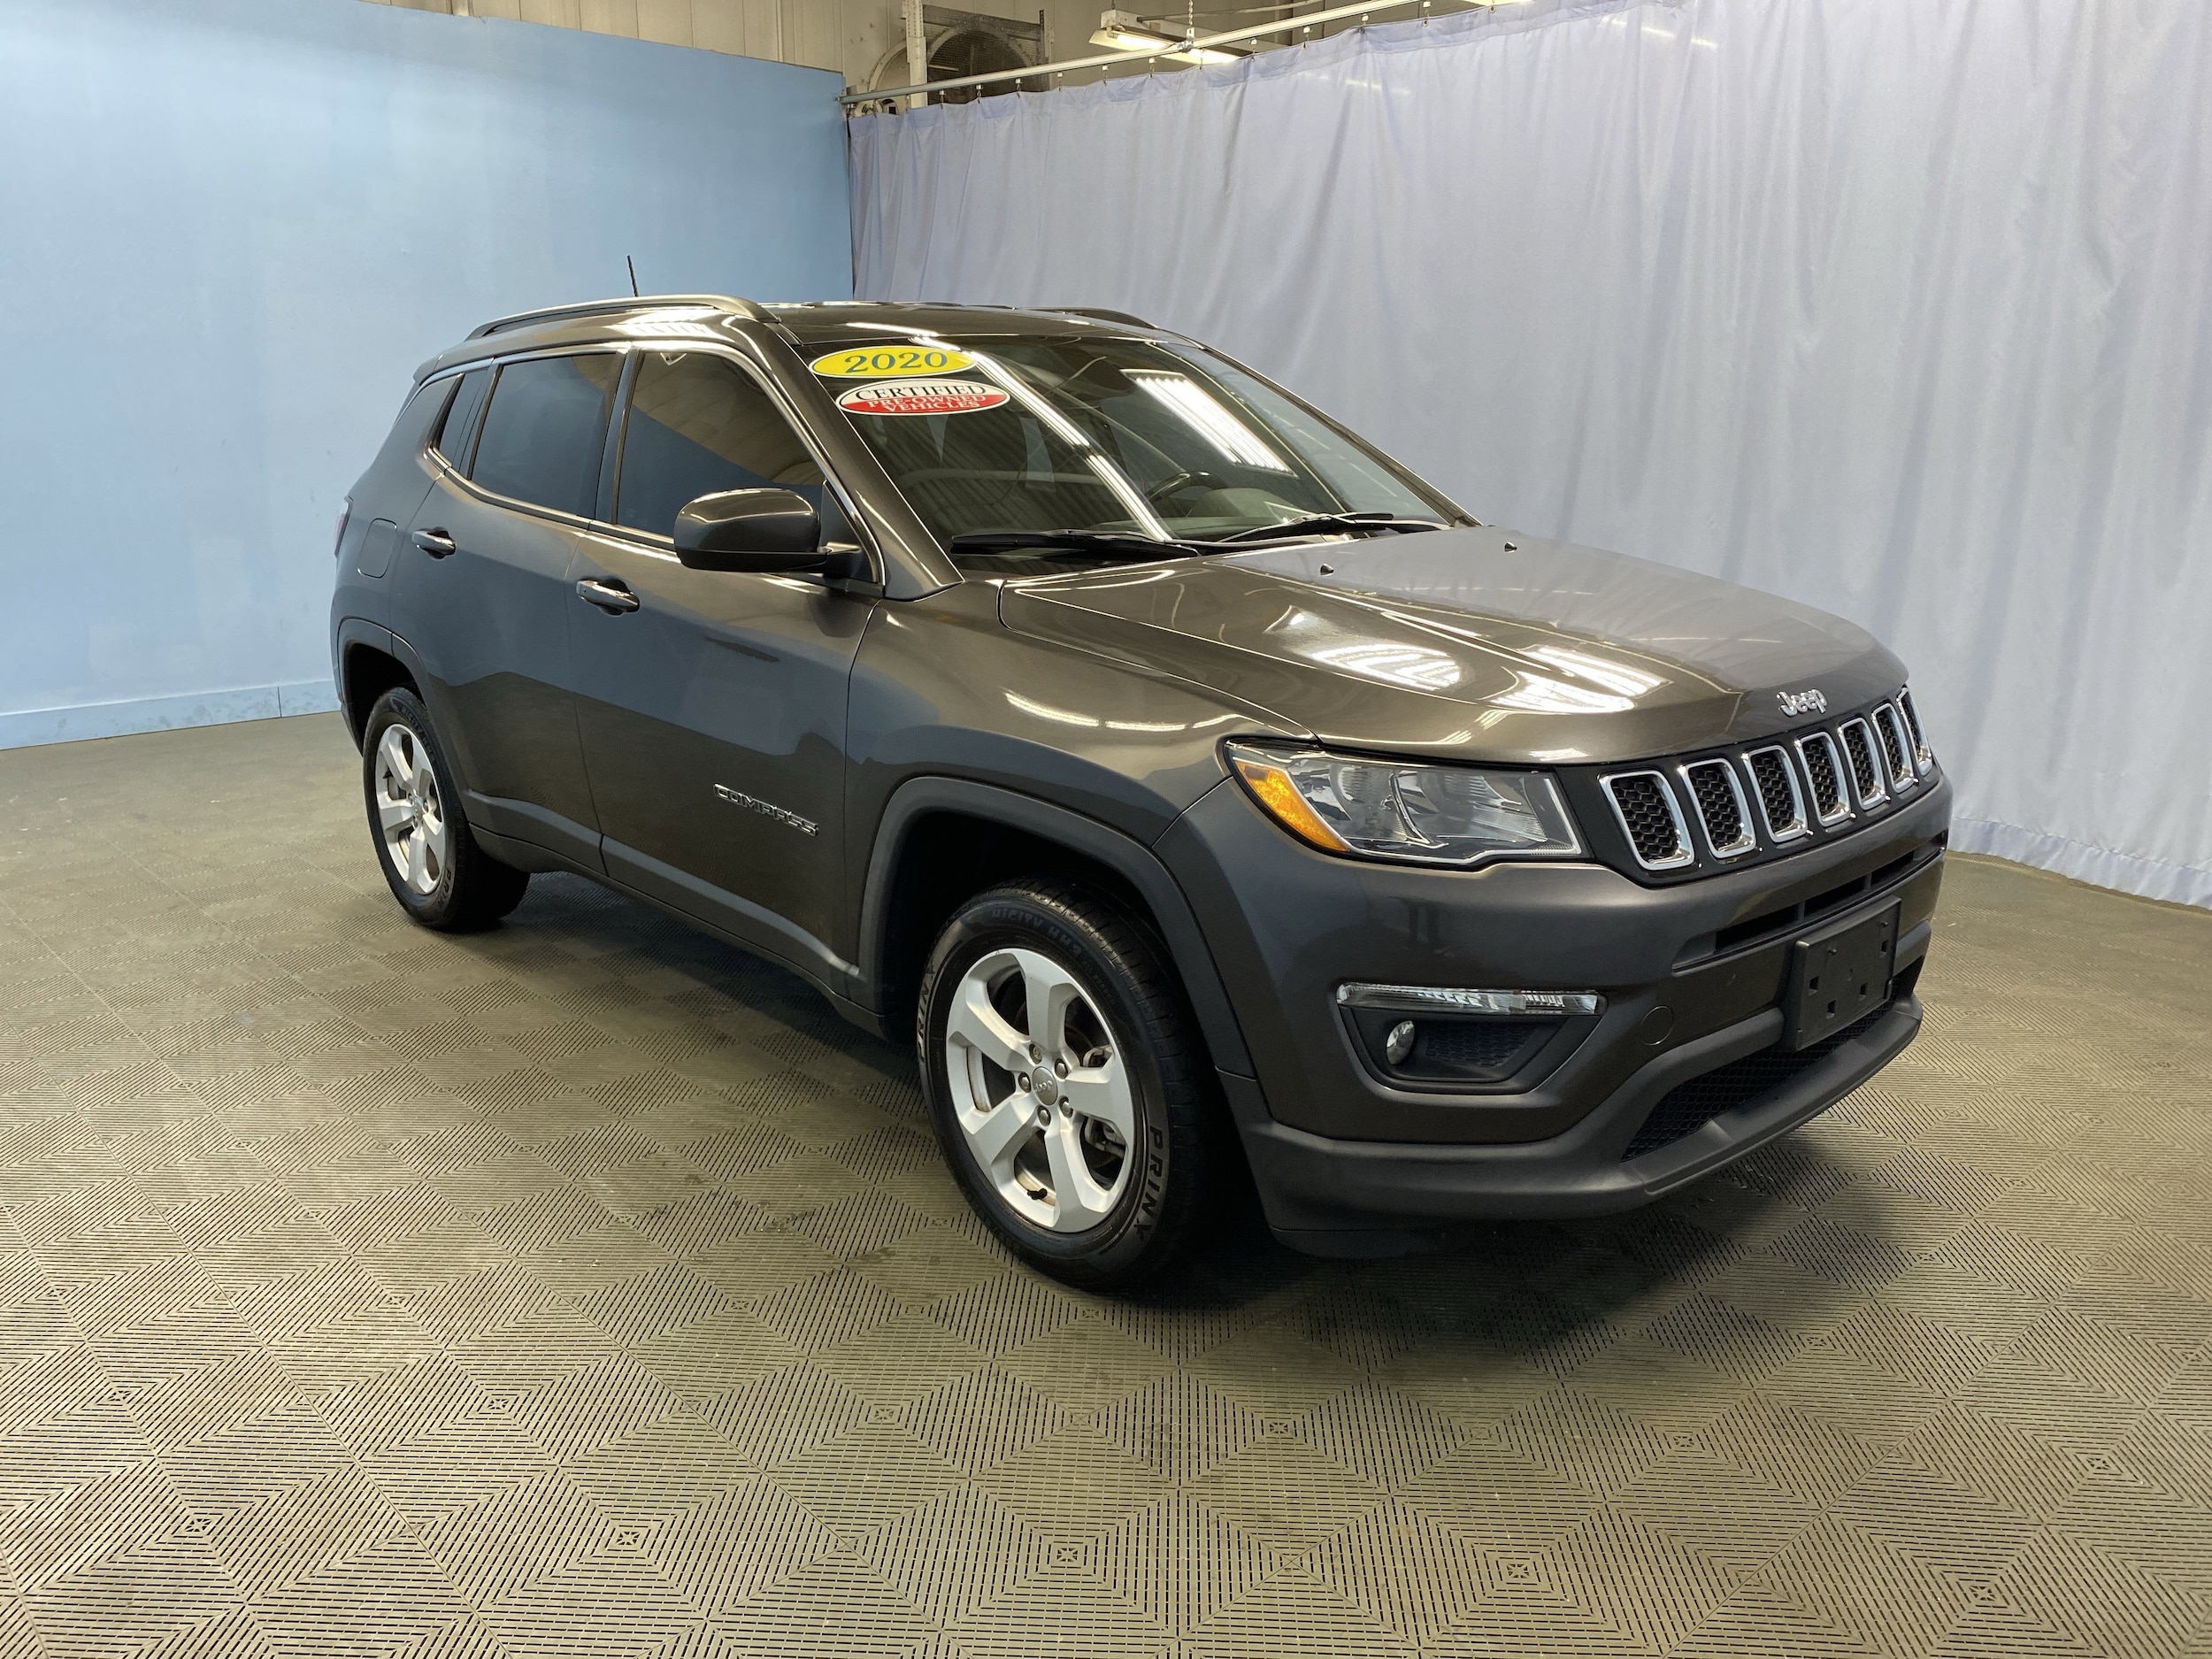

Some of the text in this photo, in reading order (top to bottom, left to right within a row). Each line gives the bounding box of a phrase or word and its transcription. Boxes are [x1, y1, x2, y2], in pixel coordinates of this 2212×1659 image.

[844, 351, 948, 373] 2020
[855, 384, 987, 402] CERTIFIED
[867, 395, 987, 408] PRE-OWNED
[884, 401, 980, 413] VEHICLES
[1777, 688, 1828, 717] Jeep
[713, 784, 819, 837] COMPASS
[1133, 1125, 1164, 1241] PRINX
